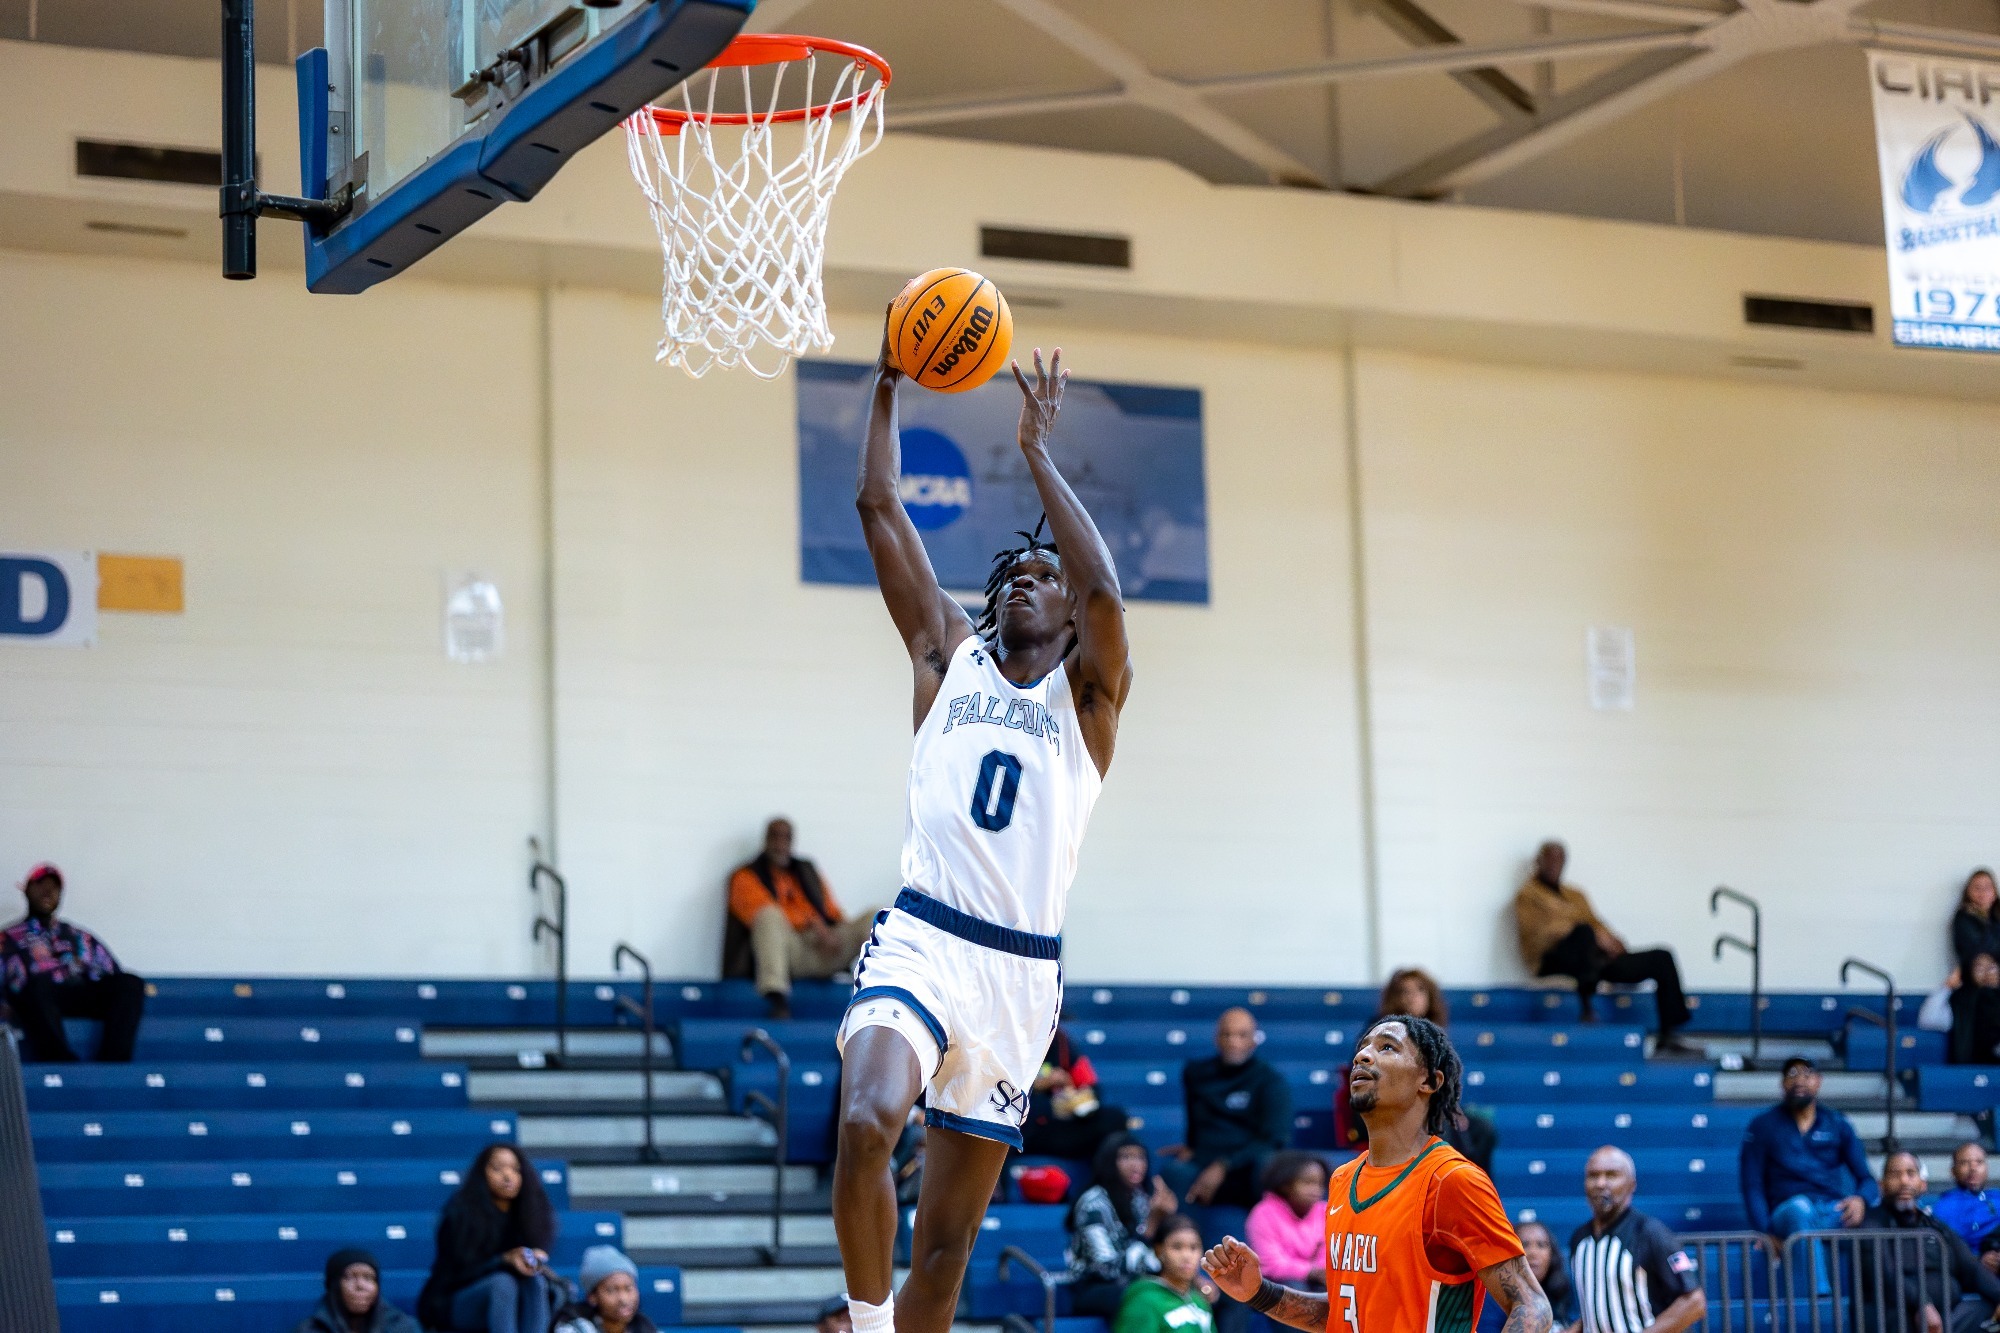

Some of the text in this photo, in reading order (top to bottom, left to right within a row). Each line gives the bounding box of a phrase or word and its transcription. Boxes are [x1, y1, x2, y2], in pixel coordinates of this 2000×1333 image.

[912, 294, 946, 343] EVO
[1914, 289, 2000, 317] 197
[933, 305, 993, 376] Wilson
[968, 748, 1024, 834] 0
[1330, 1231, 1378, 1274] MACU
[1339, 1282, 1361, 1333] 3
